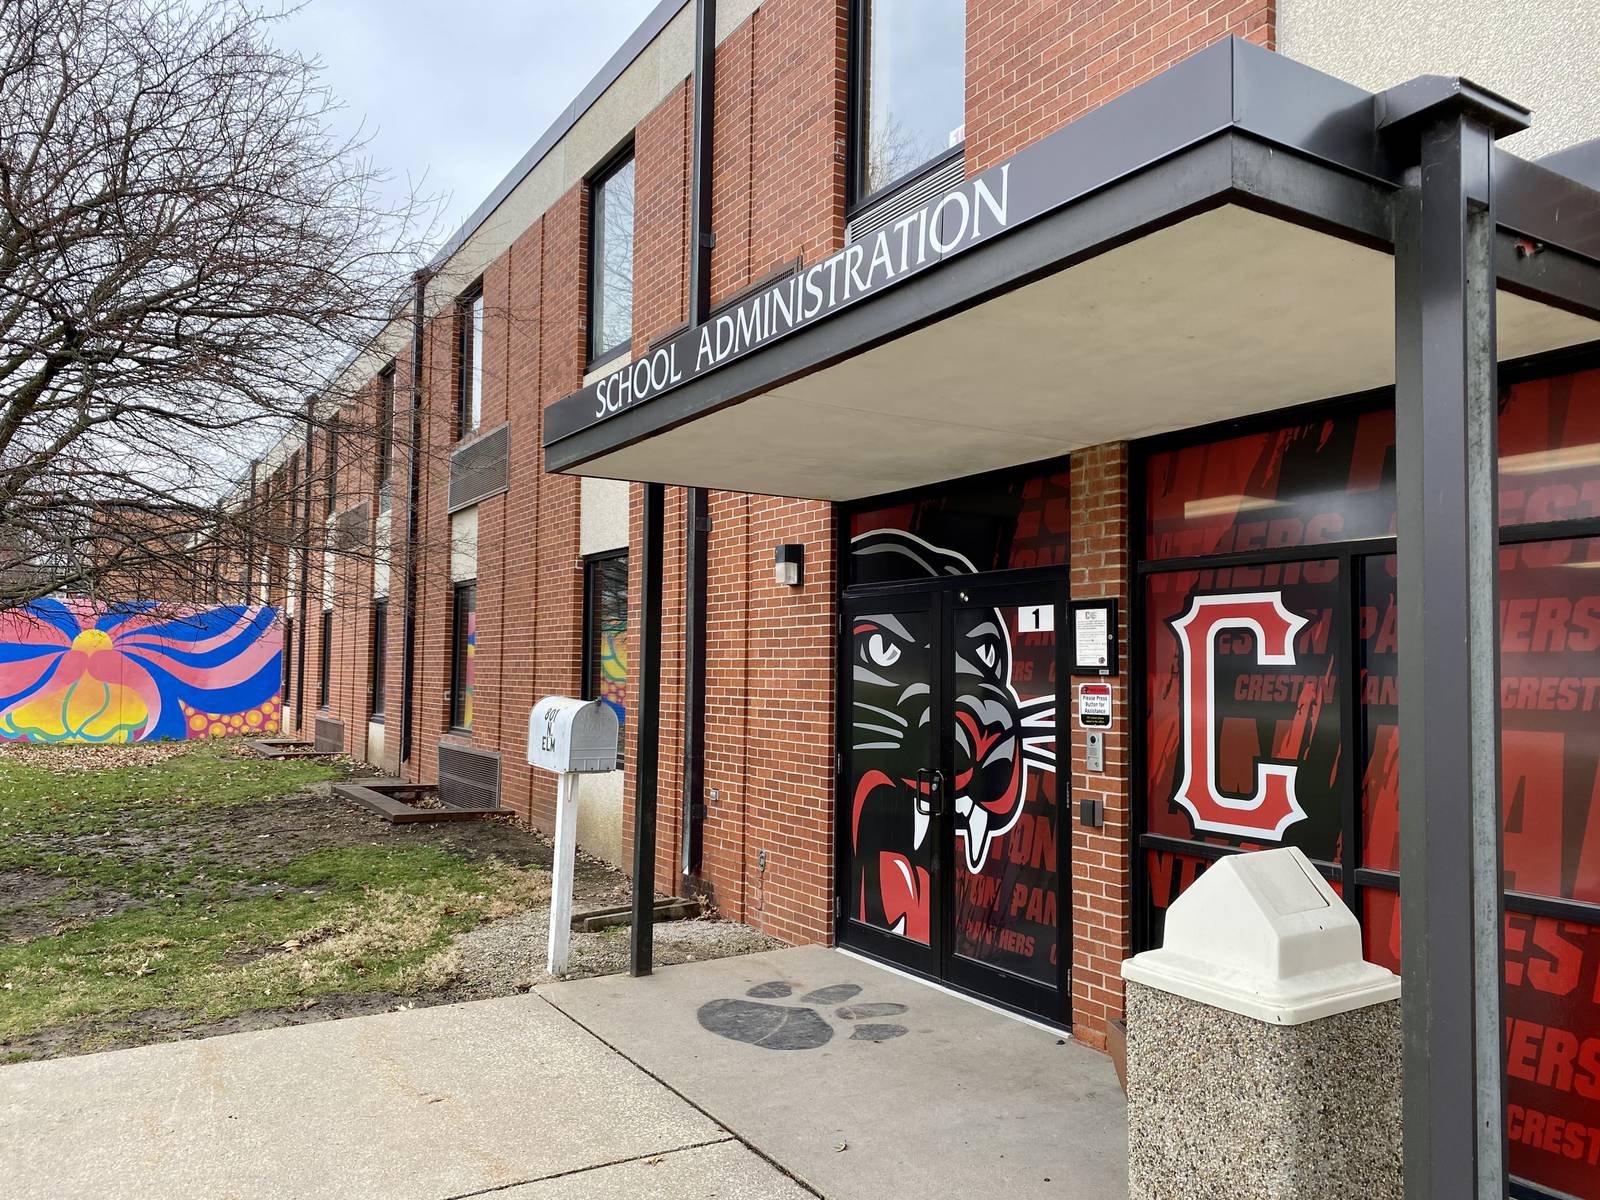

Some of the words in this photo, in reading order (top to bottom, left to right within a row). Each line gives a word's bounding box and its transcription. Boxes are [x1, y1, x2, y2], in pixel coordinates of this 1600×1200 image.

[595, 343, 682, 418] SCHOOL
[695, 163, 1010, 372] ADMINISTRATION
[1032, 608, 1040, 629] 1
[1234, 674, 1336, 704] CRESTON
[1171, 591, 1309, 841] C
[541, 736, 556, 752] ELM
